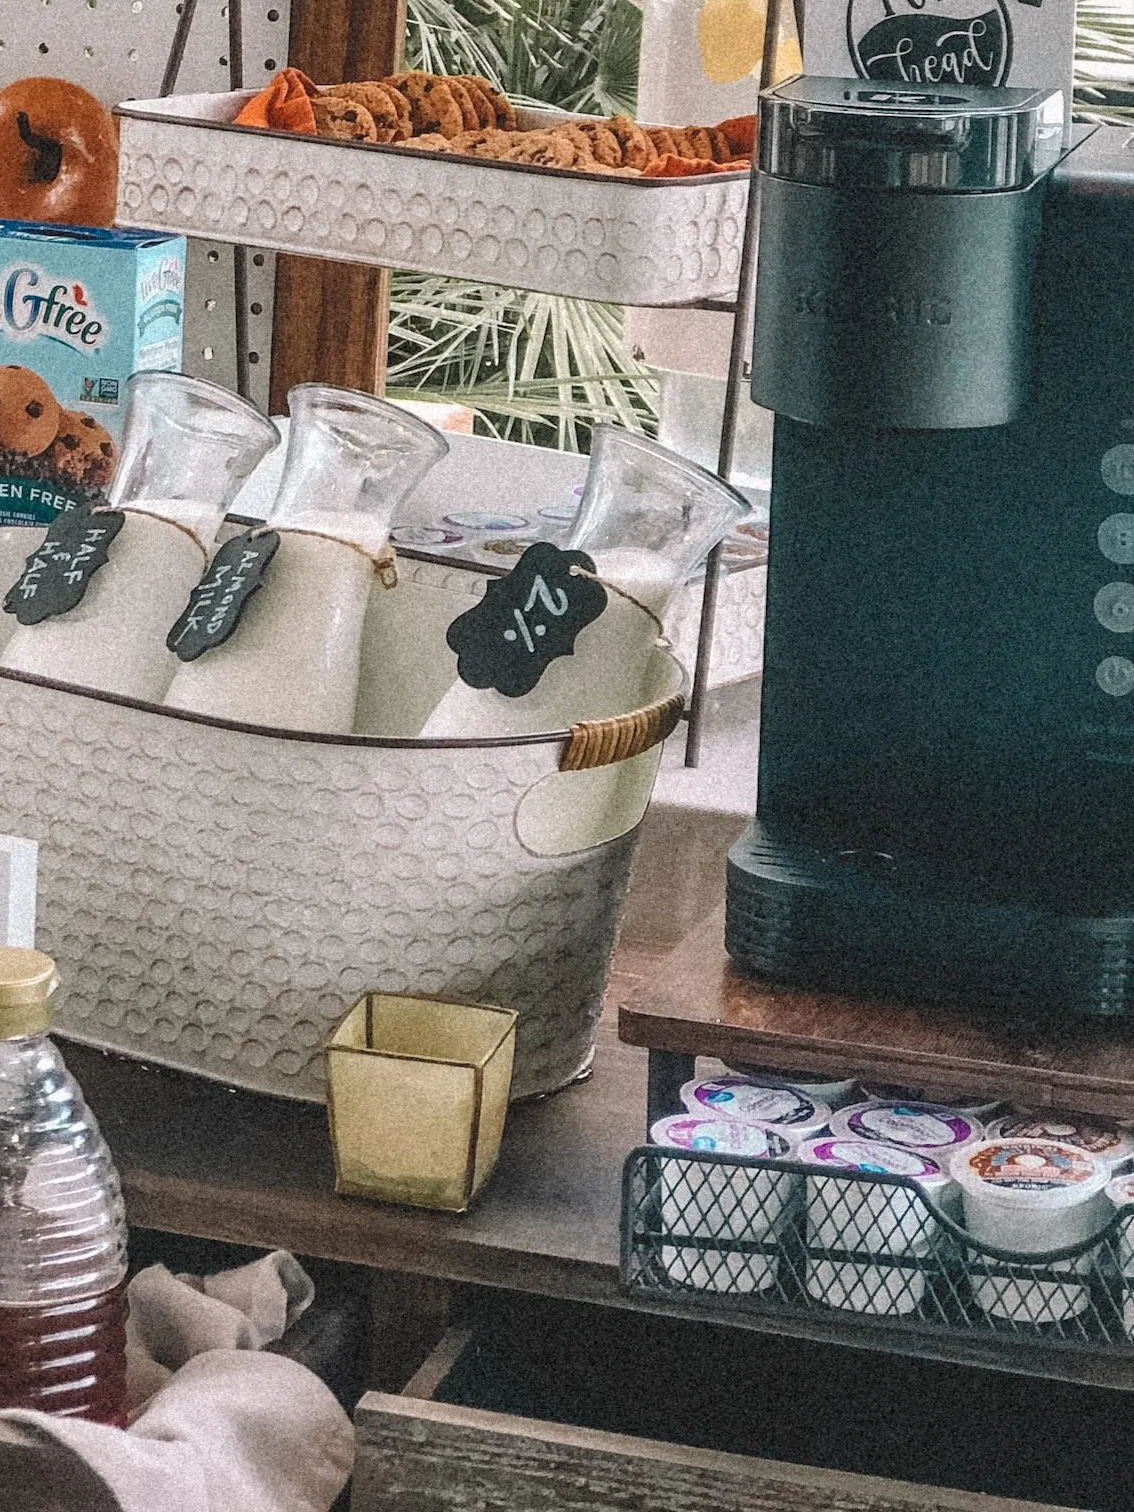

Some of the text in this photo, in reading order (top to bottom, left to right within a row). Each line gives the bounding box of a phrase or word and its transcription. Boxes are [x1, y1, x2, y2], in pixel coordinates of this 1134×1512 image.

[866, 19, 993, 84] head
[19, 541, 61, 599] HALF
[63, 528, 107, 585] HALF
[207, 550, 259, 634] ALMOND
[174, 564, 232, 646] MILK
[503, 574, 569, 653] 2%
